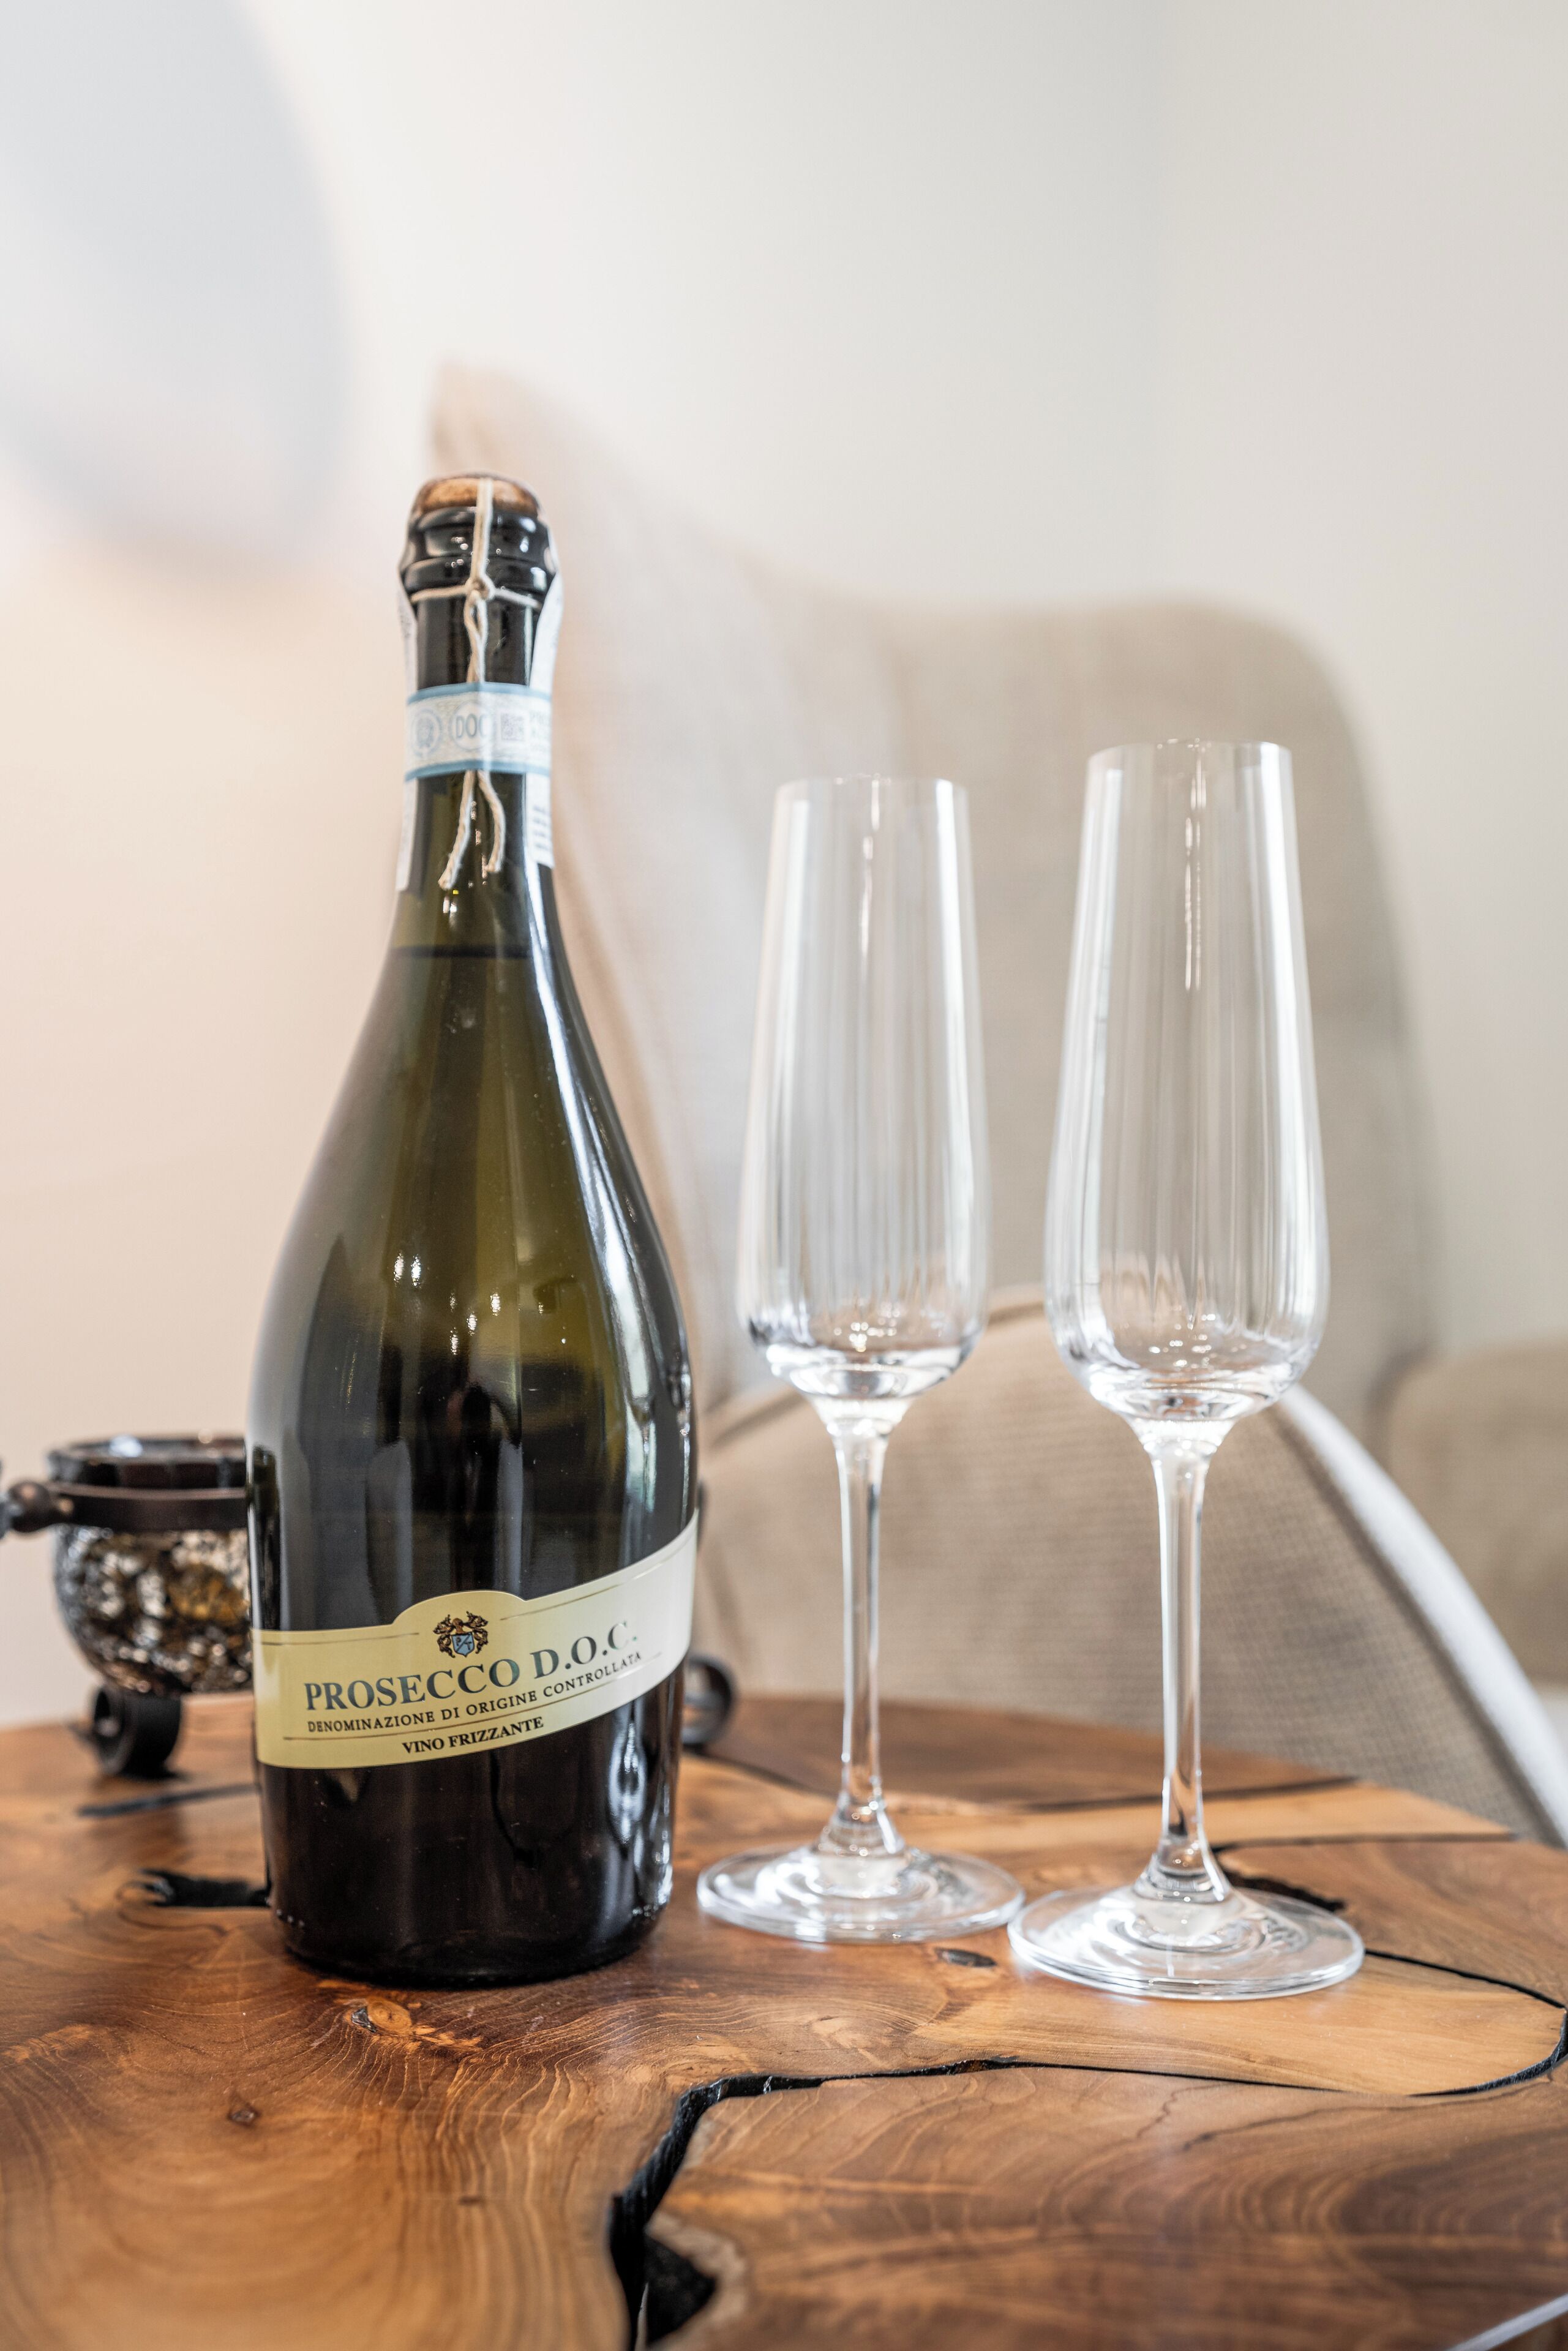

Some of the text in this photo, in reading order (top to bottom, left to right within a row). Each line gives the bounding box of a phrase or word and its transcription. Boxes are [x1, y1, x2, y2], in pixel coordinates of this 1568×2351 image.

[304, 1621, 637, 1711] PROSECCO D.O.C.
[307, 1651, 642, 1733] DENOMINAZIONE DI ORIGINE CONTROLLATA
[401, 1715, 544, 1754] VINO FRIZZANTE
